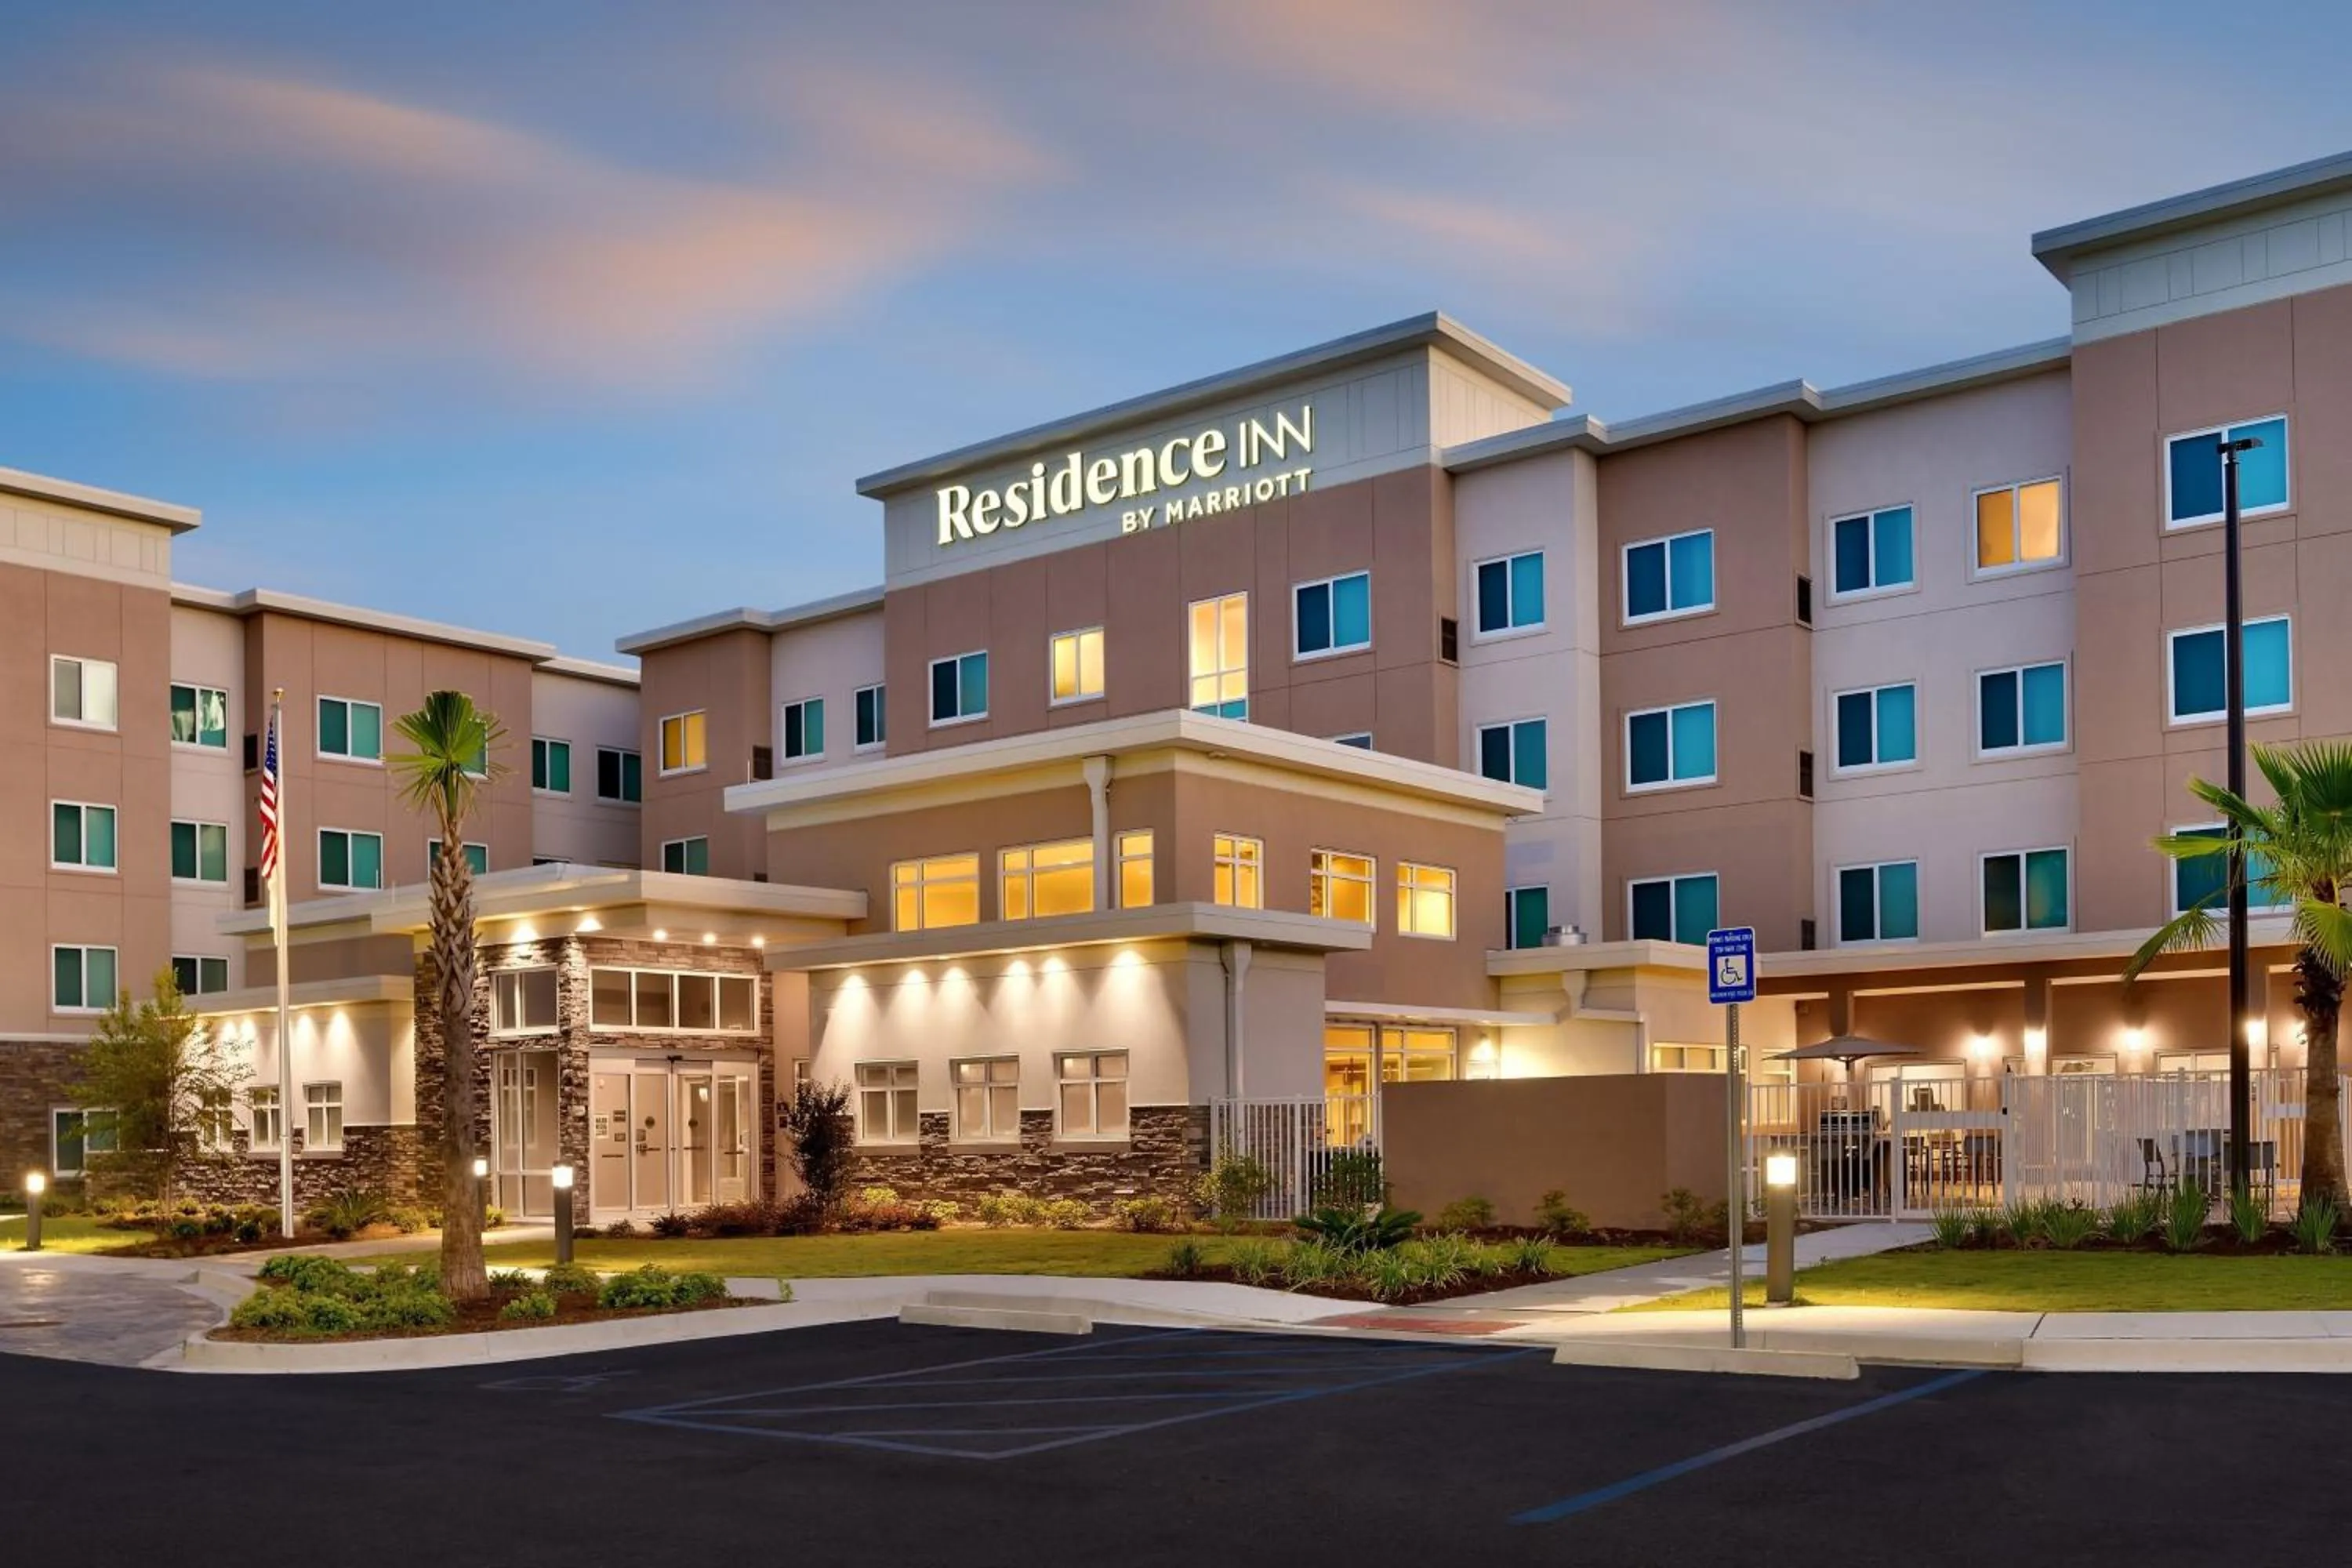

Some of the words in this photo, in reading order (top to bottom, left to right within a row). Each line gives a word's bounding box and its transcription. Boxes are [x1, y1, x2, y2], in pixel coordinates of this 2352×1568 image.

[937, 429, 1226, 544] Residence
[1240, 405, 1312, 468] INN
[1122, 506, 1156, 534] BY
[1166, 468, 1312, 523] MARRIOTT
